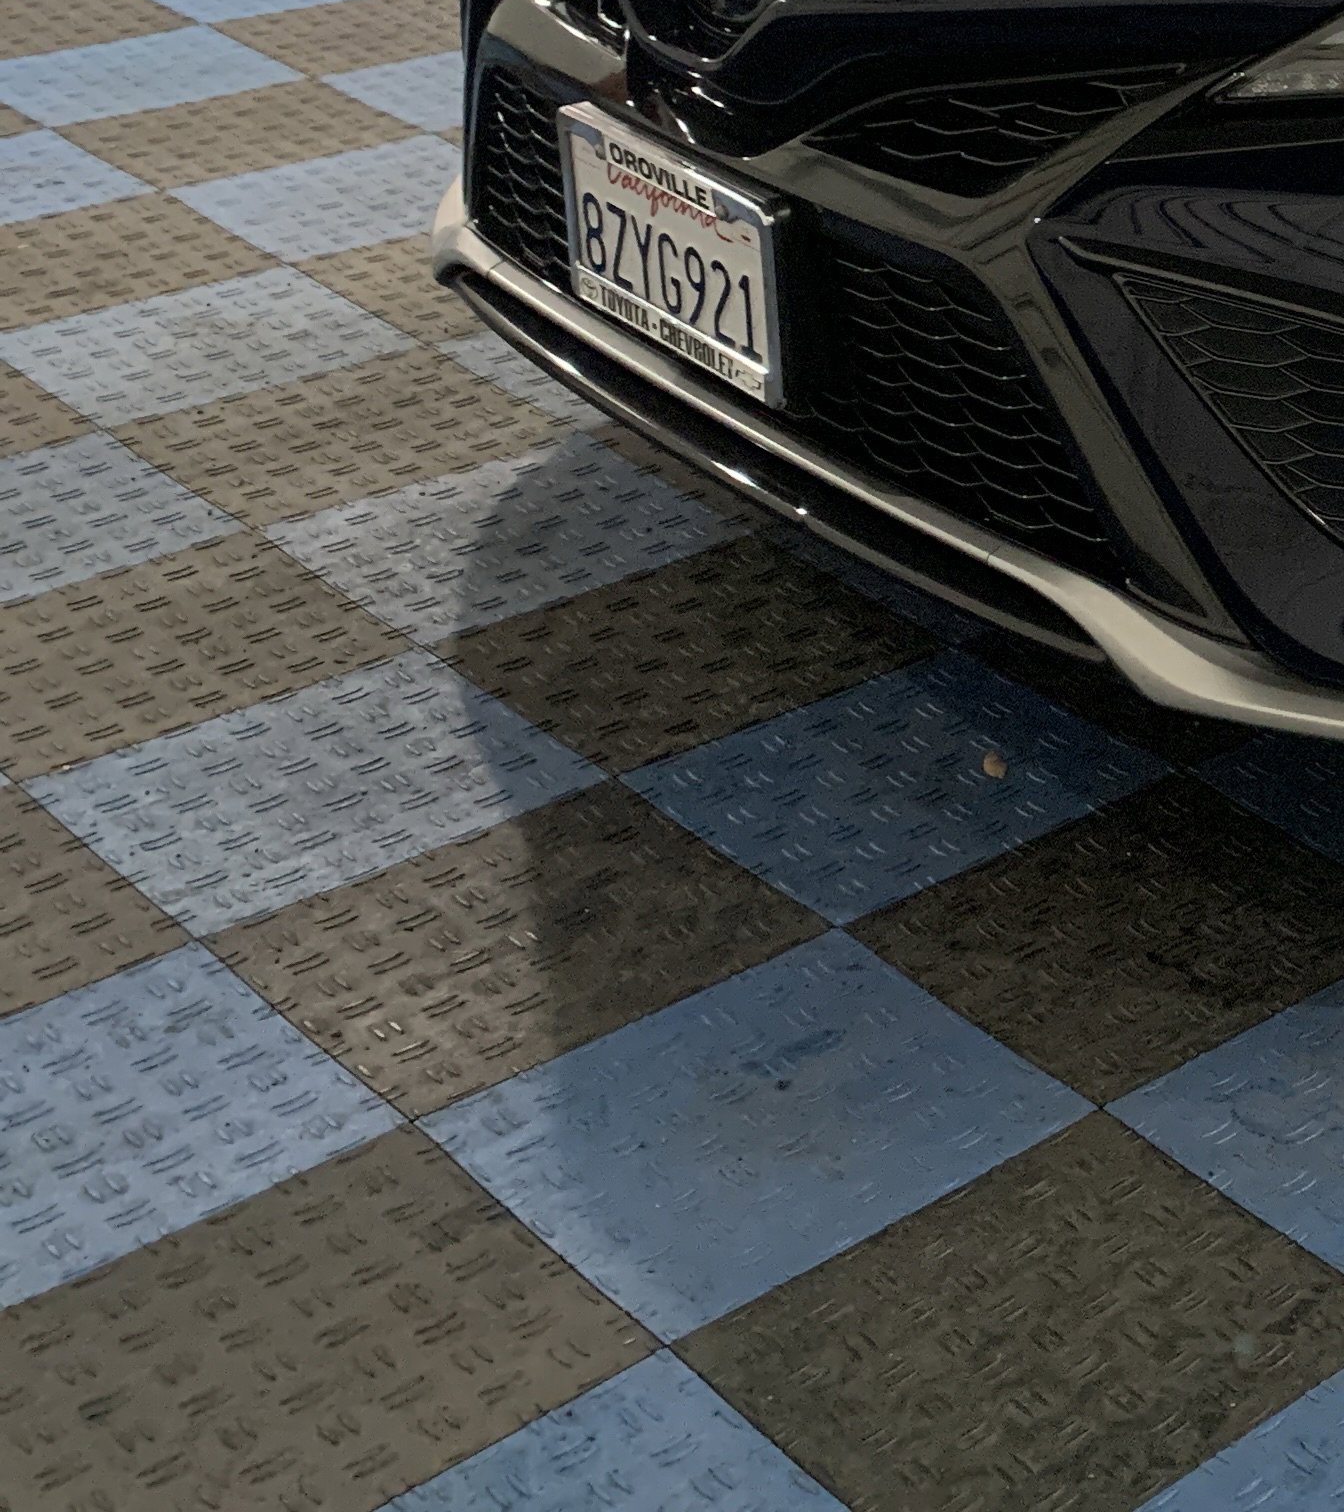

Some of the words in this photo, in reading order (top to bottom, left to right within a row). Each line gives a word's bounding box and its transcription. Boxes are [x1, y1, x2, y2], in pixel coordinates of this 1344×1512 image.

[609, 142, 707, 210] OROVILLE
[582, 192, 763, 365] 8ZYG921
[600, 285, 649, 331] TOYOTA
[659, 318, 734, 380] CHEVROLET
